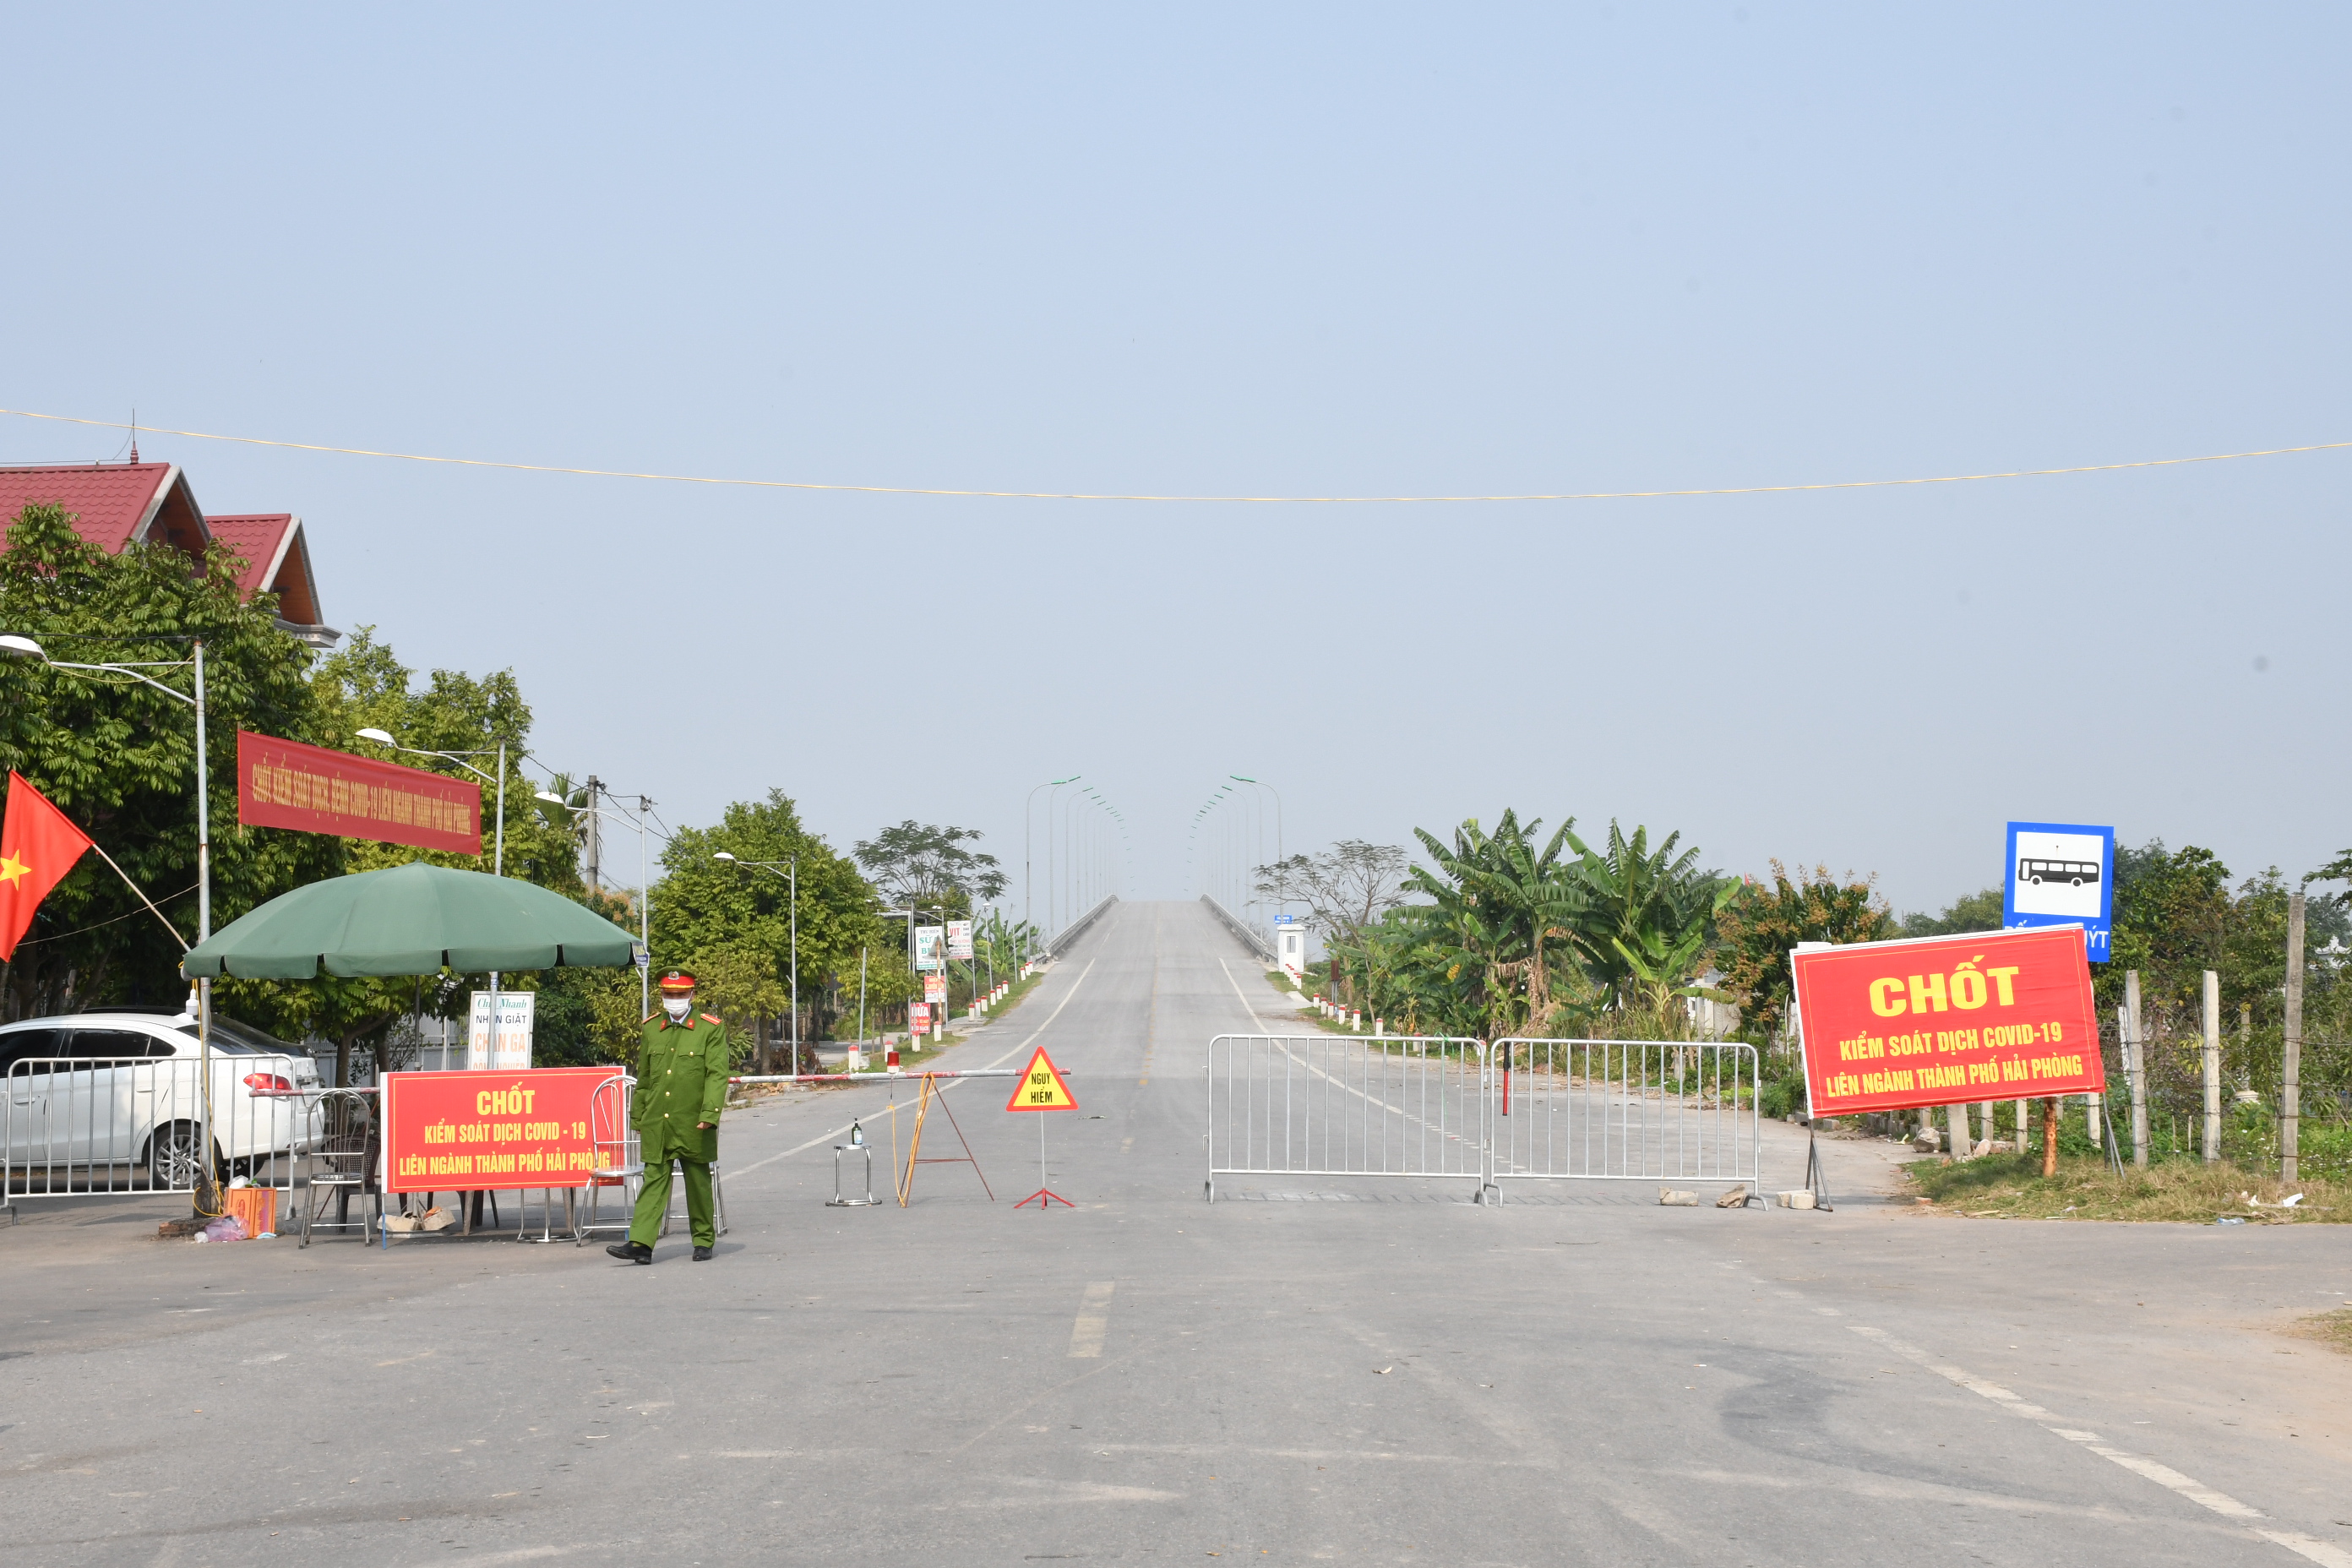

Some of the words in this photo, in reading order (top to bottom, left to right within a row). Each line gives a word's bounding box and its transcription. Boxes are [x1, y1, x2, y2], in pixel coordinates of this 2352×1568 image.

[252, 751, 271, 803] CHỐT
[273, 753, 292, 806] KIỂM
[293, 765, 312, 808] SOÁT
[378, 781, 392, 822] LIÊN
[1869, 955, 2019, 1017] CHỐT
[476, 1015, 503, 1024] NHN
[505, 1012, 527, 1026] GIẶT
[510, 1032, 526, 1053] GA
[1839, 1030, 1885, 1061] KIỂM
[1888, 1029, 1932, 1057] SOÁT
[1936, 1027, 1979, 1056] DỊCH
[1983, 1021, 2062, 1048] COVID-19
[1031, 1072, 1051, 1086] NGUY
[1826, 1071, 1860, 1097] LIÊN
[1862, 1067, 1914, 1094] NGÀNH
[1917, 1063, 1966, 1089] THÀNH
[1968, 1054, 2000, 1085] PHỐ
[2002, 1053, 2028, 1082] HẢI
[2031, 1052, 2083, 1080] PHÒNG
[476, 1081, 536, 1115] CHỐT
[1031, 1086, 1053, 1103] HIỂM
[424, 1118, 455, 1144] KIỂM
[459, 1120, 490, 1143] SOÁT
[493, 1123, 521, 1146] DỊCH
[525, 1122, 559, 1141] COVID
[571, 1121, 586, 1140] 19
[399, 1153, 427, 1176] LIÊN
[429, 1152, 472, 1175] NGÀNH
[476, 1151, 515, 1173] THÀNH
[519, 1147, 543, 1172] PHỐ
[546, 1147, 566, 1171] HẢI
